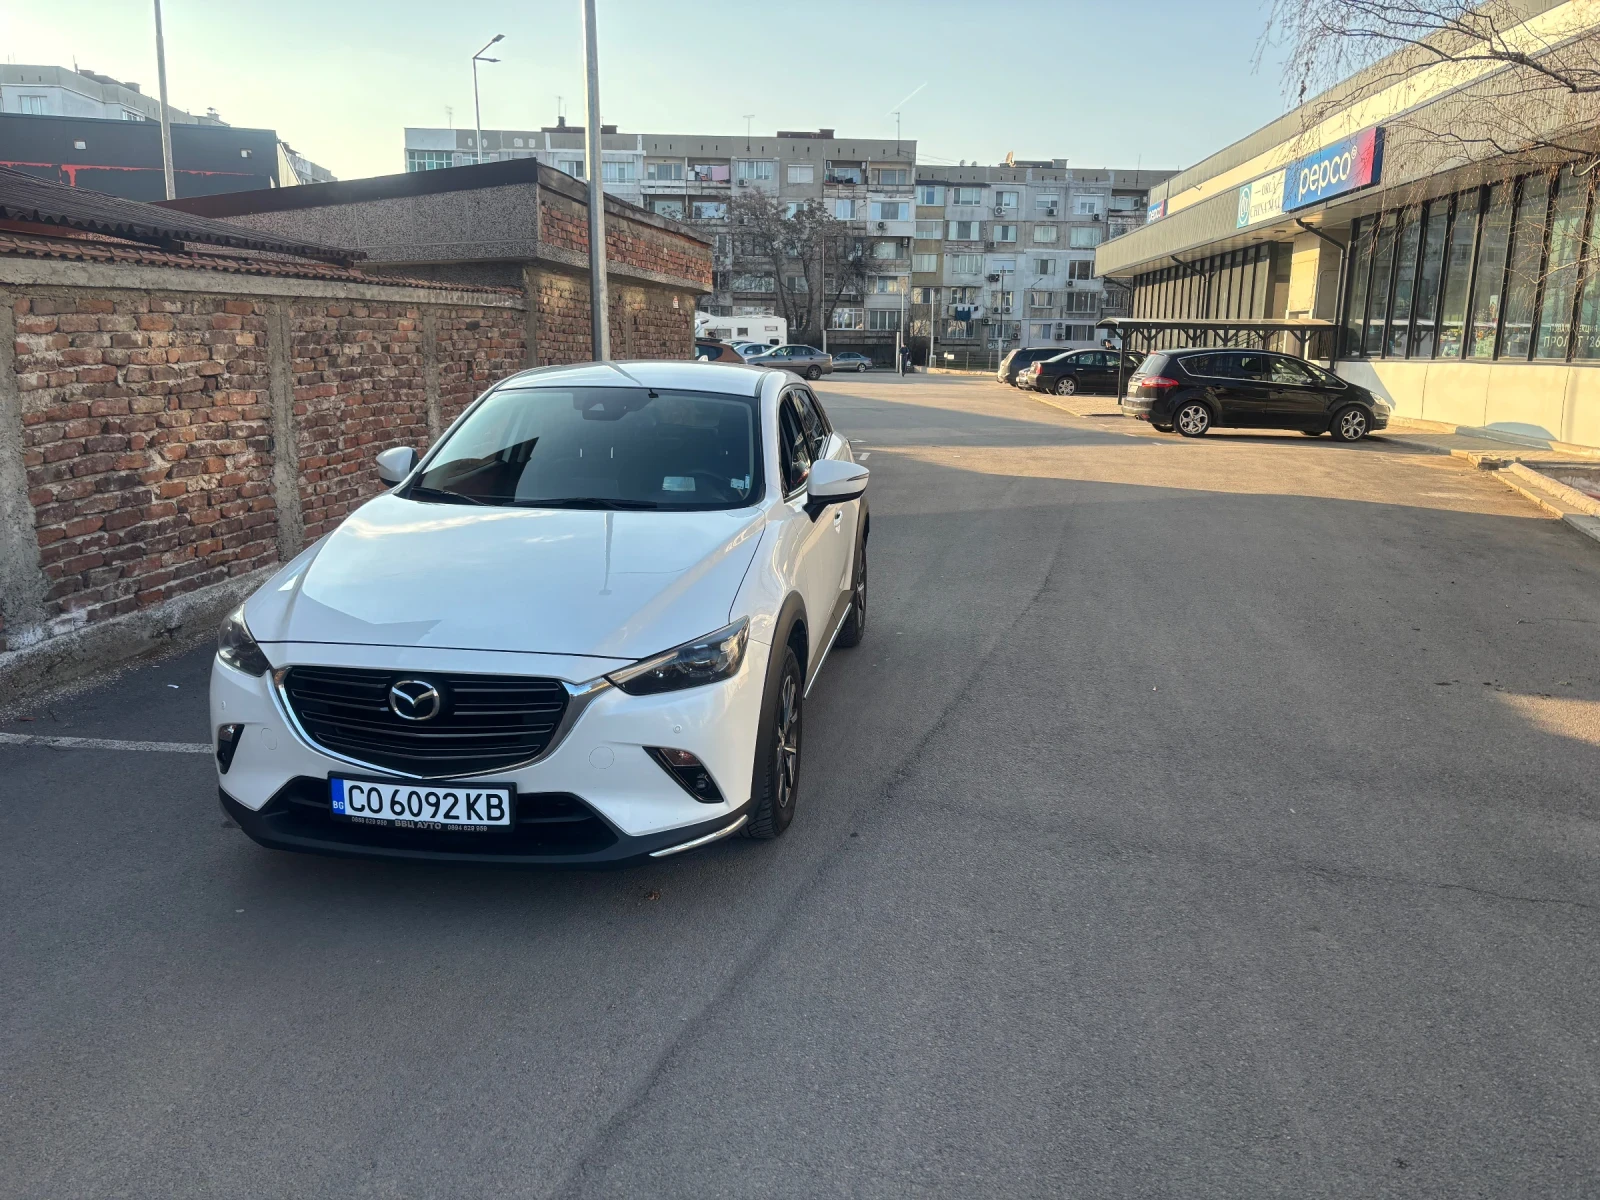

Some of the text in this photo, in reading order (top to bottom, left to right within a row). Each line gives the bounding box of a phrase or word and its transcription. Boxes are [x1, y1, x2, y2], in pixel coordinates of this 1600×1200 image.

[1298, 151, 1352, 202] pepco
[332, 800, 345, 810] BG
[390, 789, 460, 820] 6092
[465, 793, 505, 821] KB
